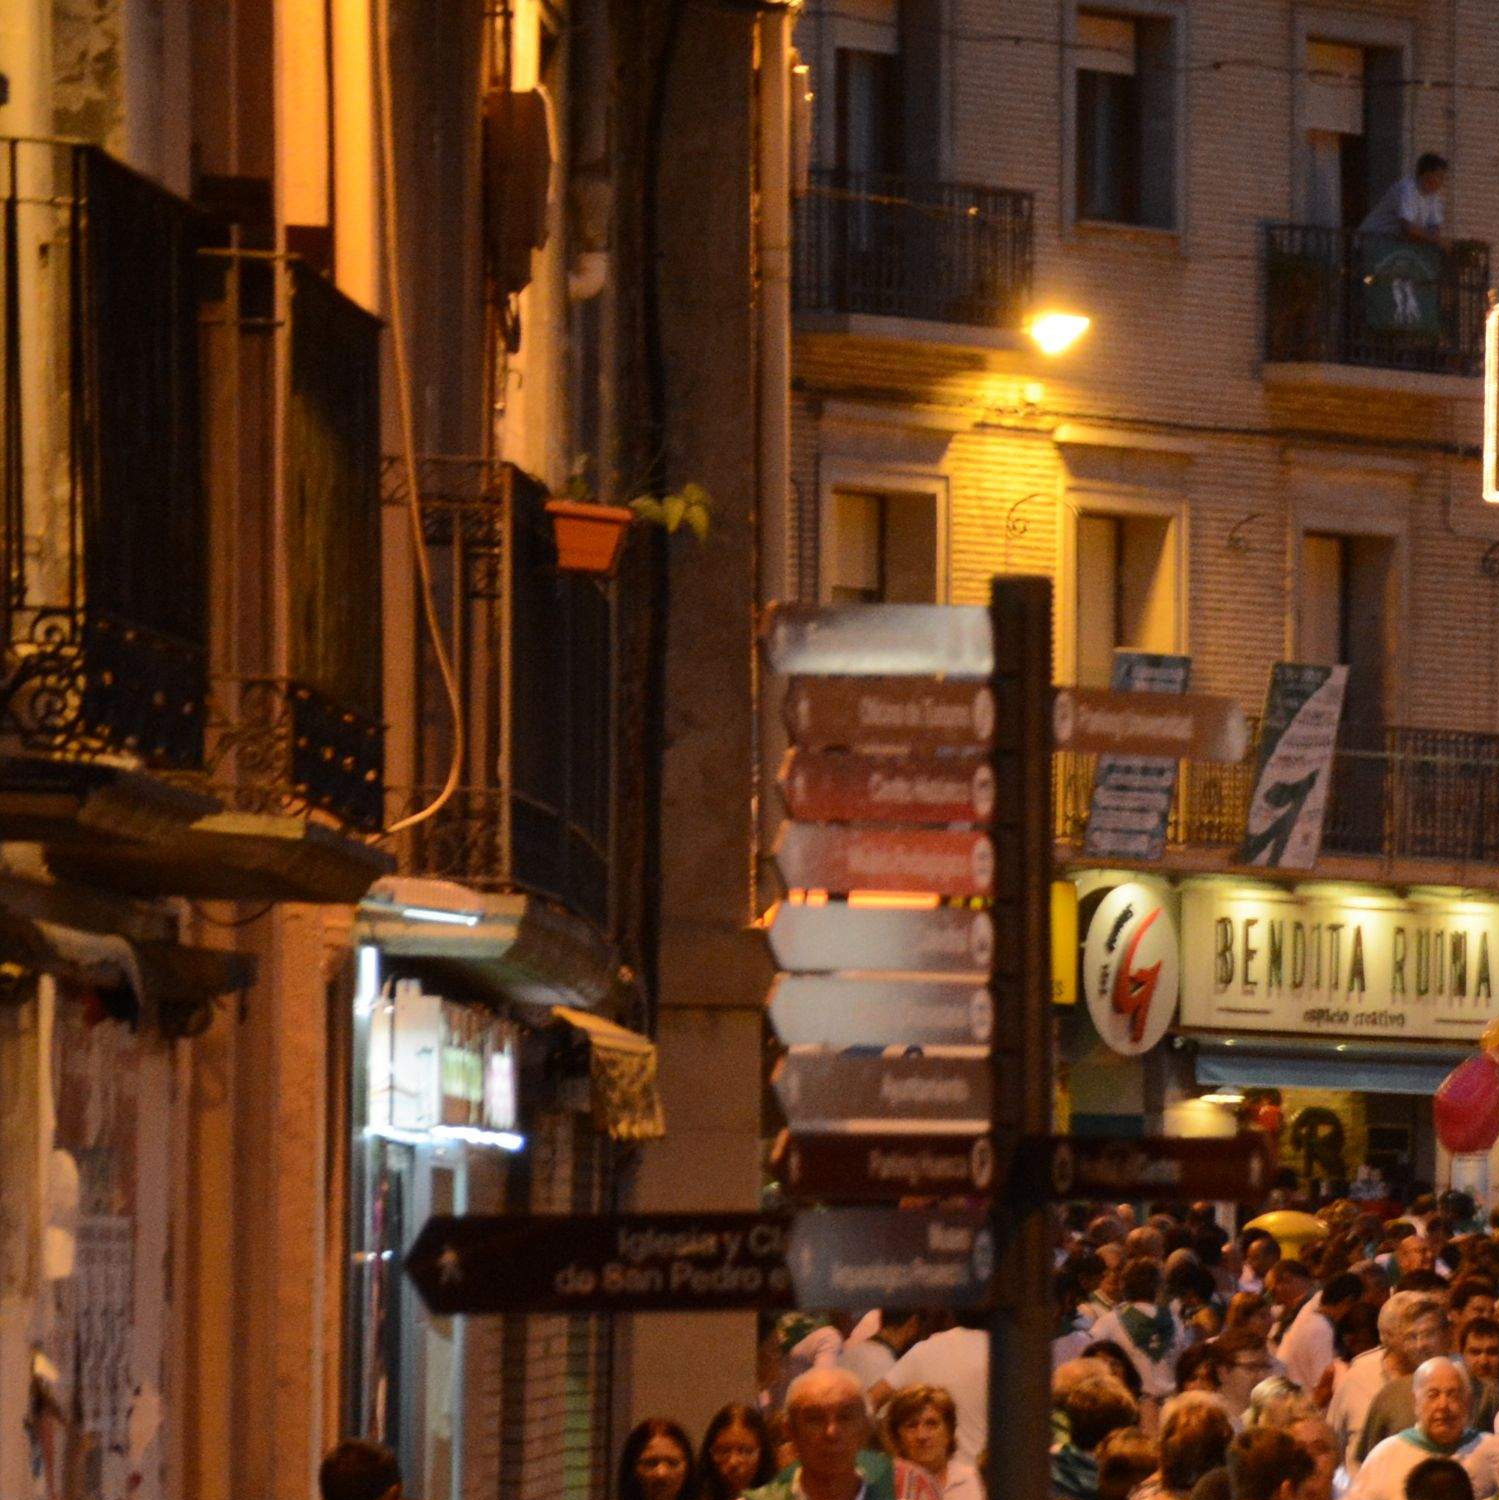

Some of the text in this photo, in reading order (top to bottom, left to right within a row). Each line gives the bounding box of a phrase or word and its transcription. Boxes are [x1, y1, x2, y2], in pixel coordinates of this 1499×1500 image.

[1214, 917, 1366, 994] BENDITA
[1393, 926, 1492, 1000] RUINA
[554, 1263, 597, 1296] de
[601, 1261, 664, 1293] San
[671, 1260, 763, 1293] Pedro
